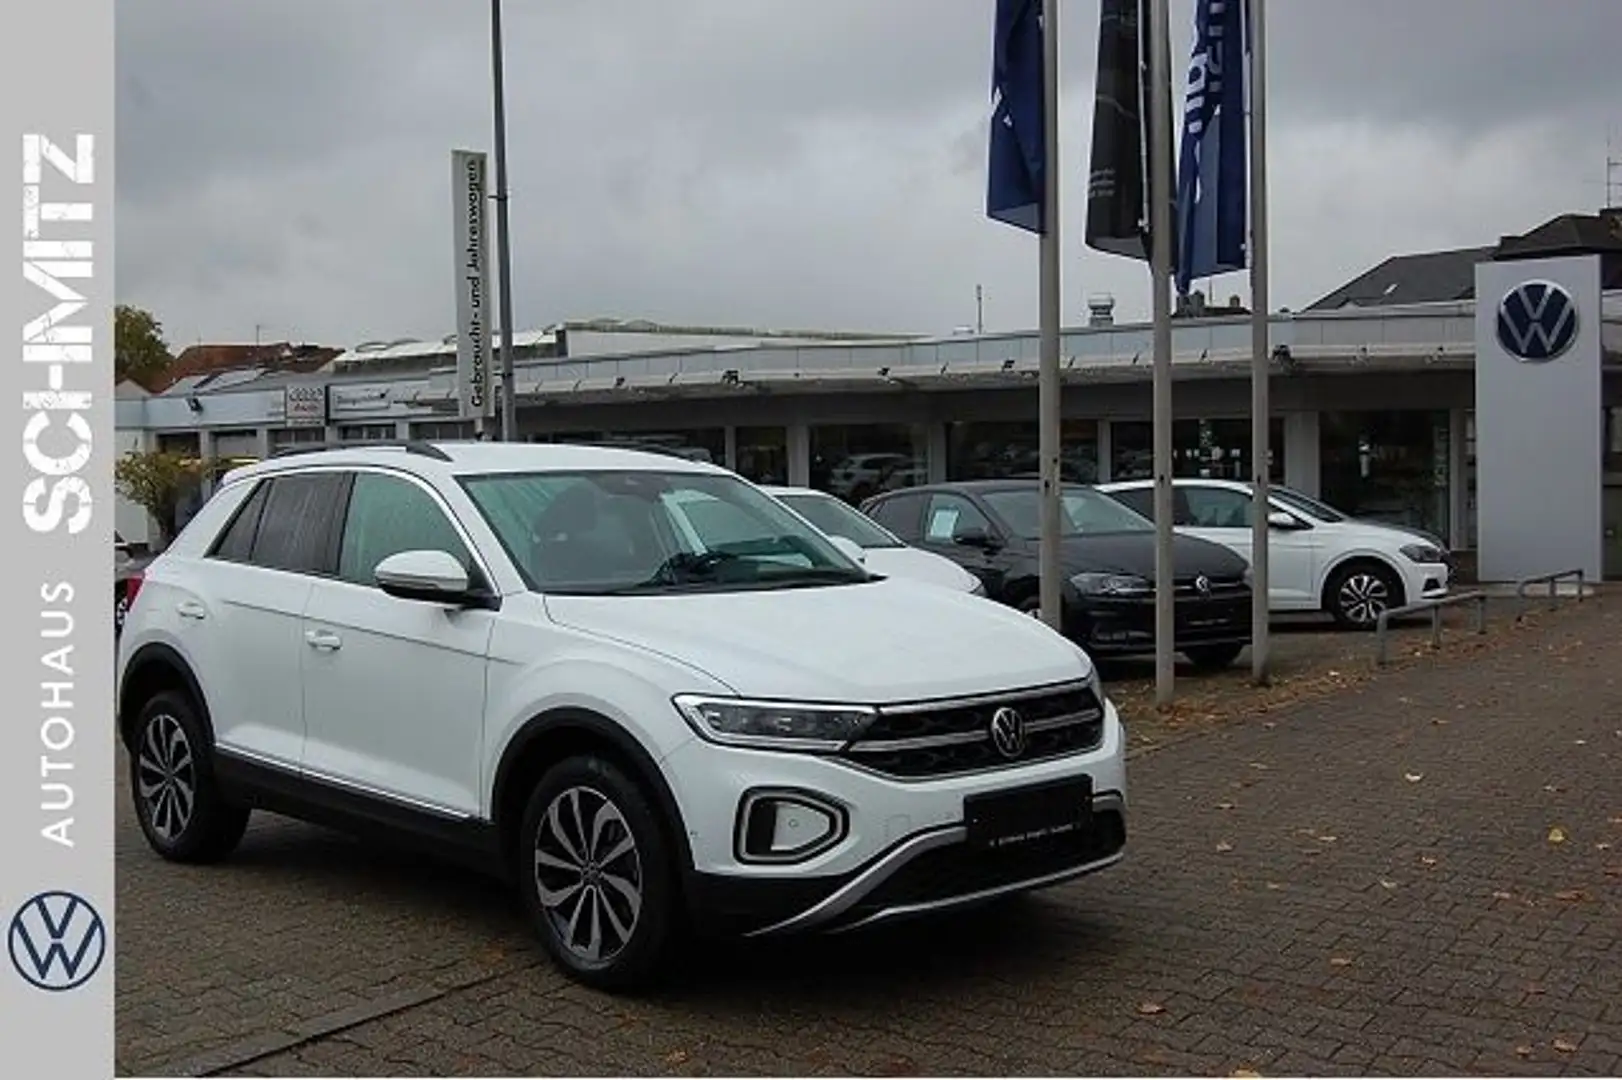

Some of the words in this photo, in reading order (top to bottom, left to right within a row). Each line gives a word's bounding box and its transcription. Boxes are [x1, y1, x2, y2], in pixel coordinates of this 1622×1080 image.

[466, 159, 481, 272] Jahreswagen
[467, 276, 481, 309] und
[1498, 281, 1577, 359] VW
